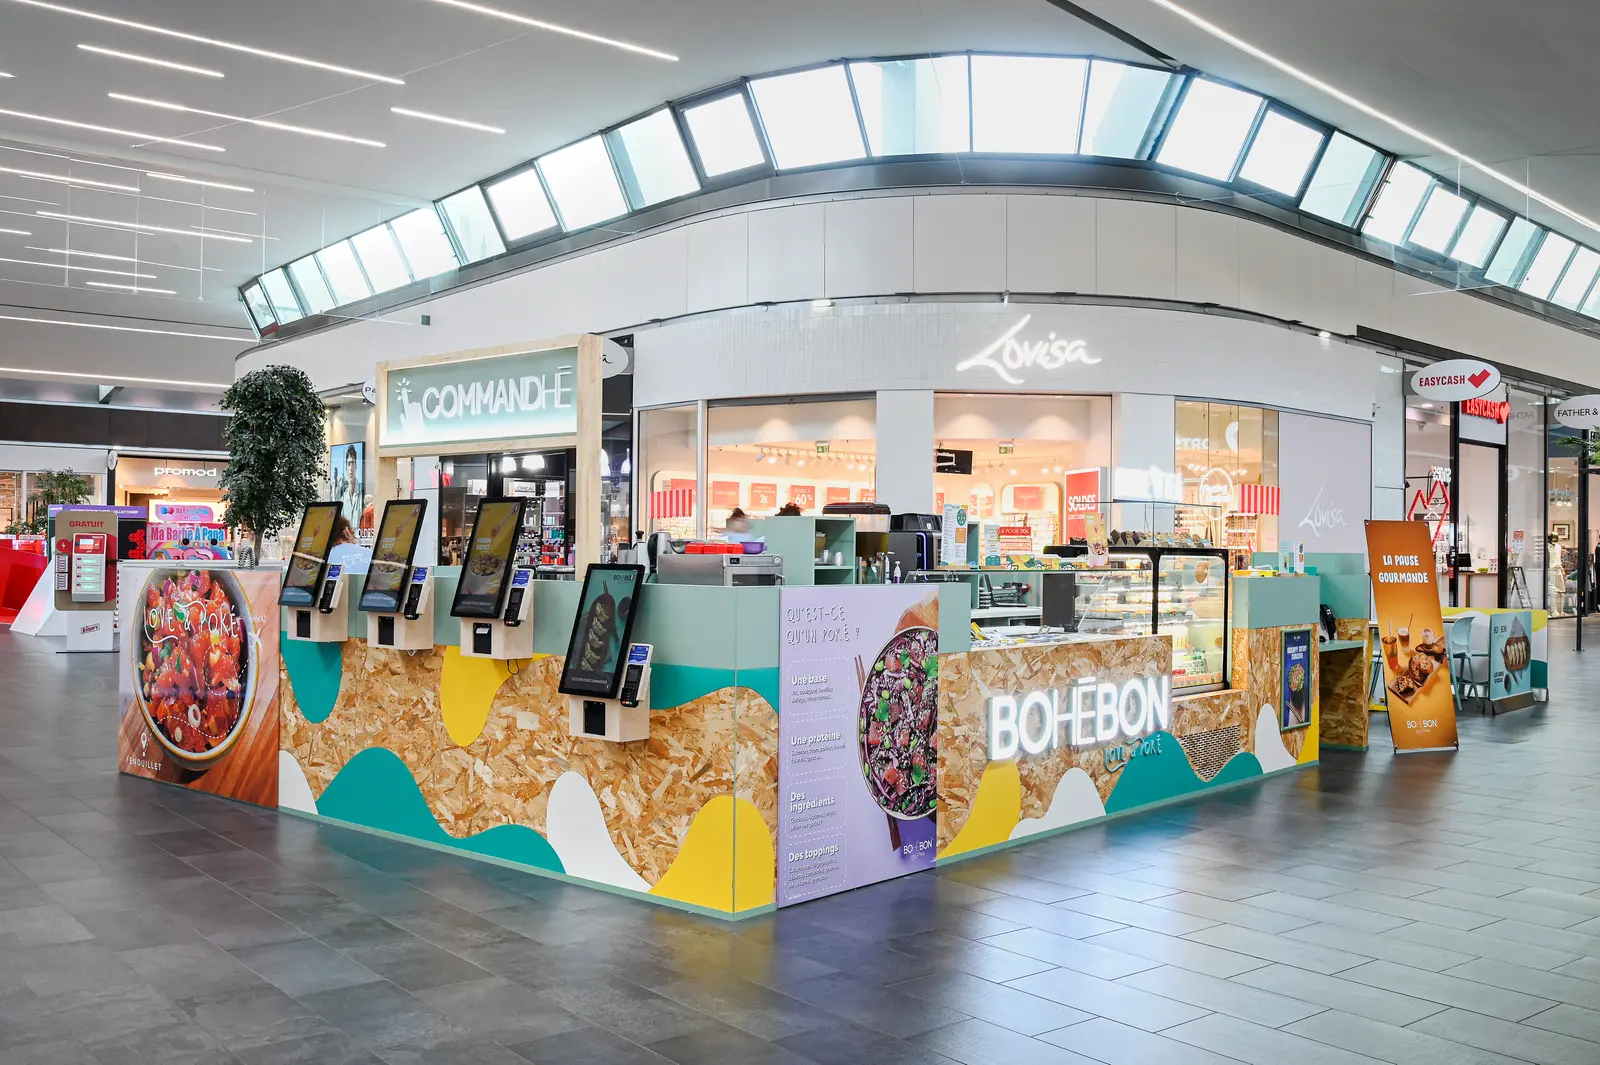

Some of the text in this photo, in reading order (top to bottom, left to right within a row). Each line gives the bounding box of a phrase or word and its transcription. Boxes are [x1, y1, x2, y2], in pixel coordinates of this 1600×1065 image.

[956, 314, 1102, 385] Lovisa
[1419, 375, 1465, 387] EASYCASH
[1466, 399, 1500, 419] EASYCASH
[1557, 408, 1599, 417] FATHER &
[154, 467, 217, 477] promod
[1068, 494, 1096, 512] SOLDES
[1299, 484, 1349, 537] Lovisa
[151, 527, 164, 541] Ma
[167, 526, 193, 541] Barbe
[357, 528, 374, 538] OLDES
[1383, 555, 1420, 566] LA PAUSE
[1378, 572, 1429, 583] GOURMANDE
[144, 601, 239, 643] LOVE & POKÉ
[786, 606, 846, 623] QU'EST-CE
[786, 623, 860, 645] QU'UN POKÉ ?
[791, 674, 828, 686] Une base
[791, 731, 841, 746] Une protéine
[126, 756, 162, 771] FENOUILLET
[790, 791, 806, 802] Des
[790, 795, 836, 814] ingrédients
[788, 844, 840, 863] Des toppings
